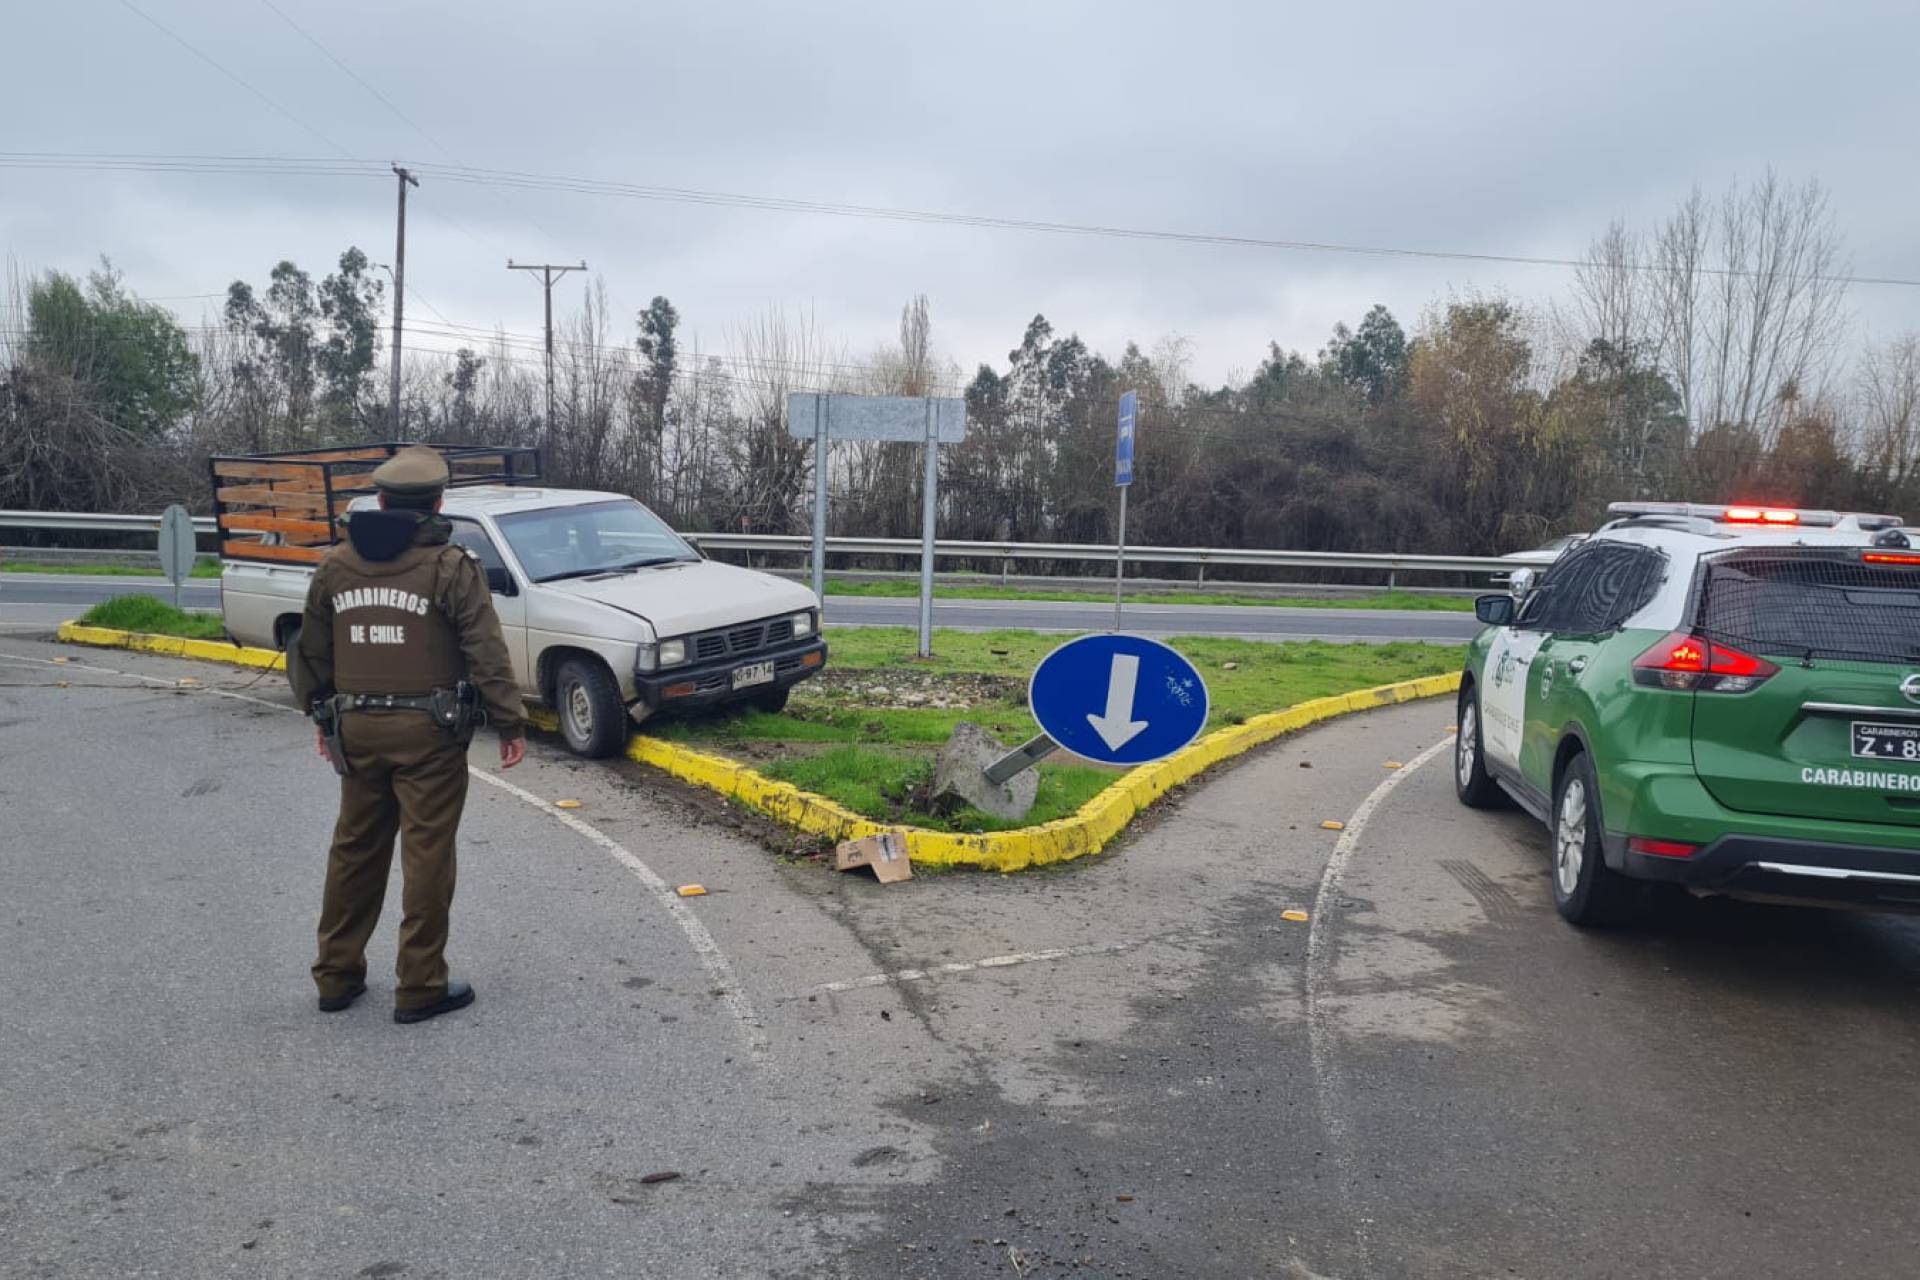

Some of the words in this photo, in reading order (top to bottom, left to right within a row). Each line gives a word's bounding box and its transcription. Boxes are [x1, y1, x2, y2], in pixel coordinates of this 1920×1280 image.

[332, 587, 429, 616] CARABINEROS
[350, 625, 365, 643] DE
[369, 625, 405, 644] CHILE
[1902, 740, 1920, 759] 8
[1801, 767, 1920, 792] CARABINERO
